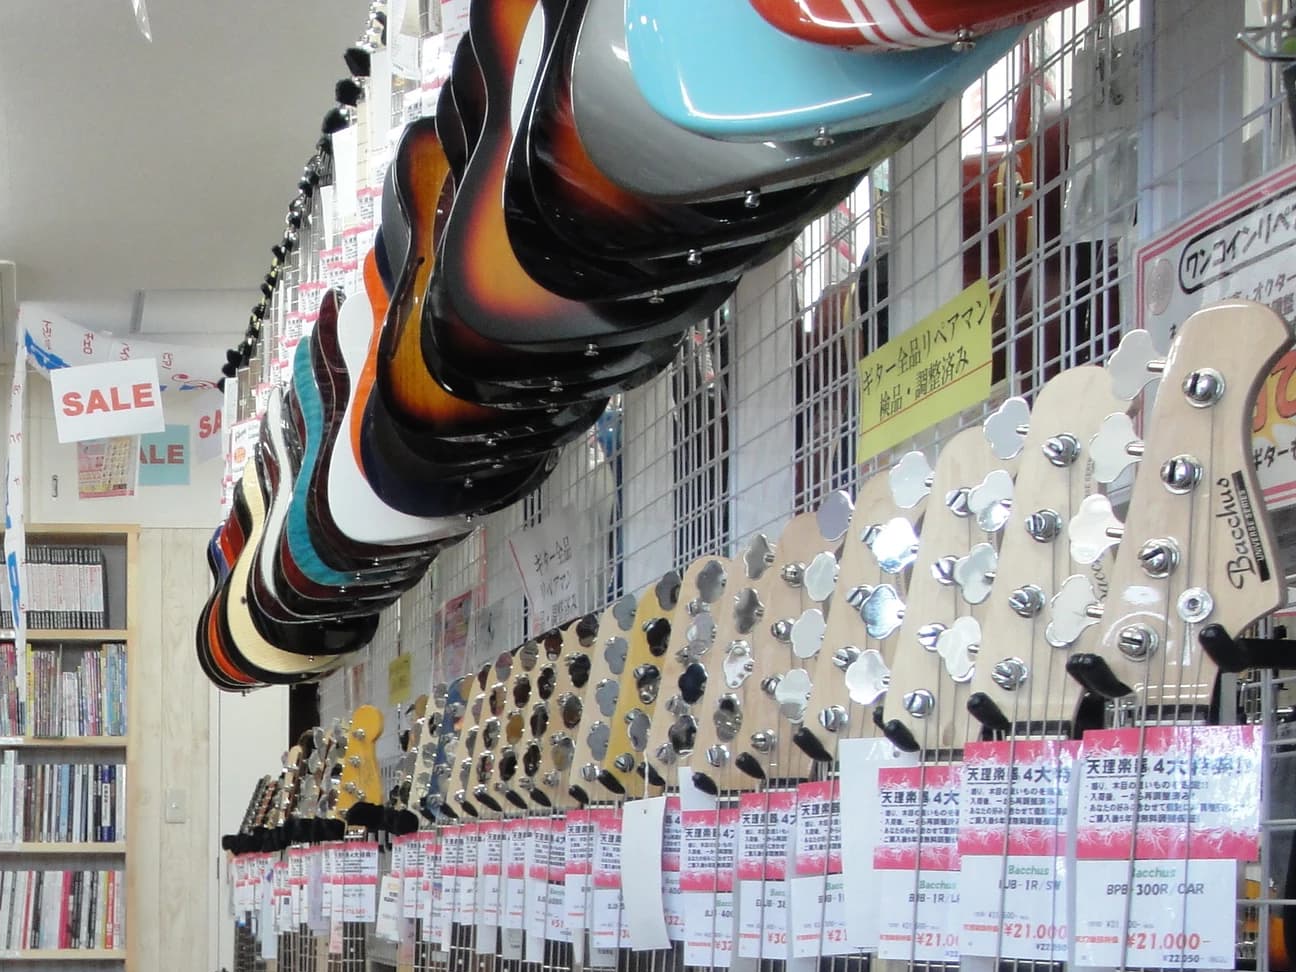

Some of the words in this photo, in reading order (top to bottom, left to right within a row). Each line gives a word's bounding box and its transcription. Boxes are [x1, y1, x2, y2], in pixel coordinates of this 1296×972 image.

[1185, 204, 1296, 280] ワンコインリペ
[862, 299, 989, 396] ギター全品リペアマン
[878, 345, 970, 418] 検品・調整済み
[62, 382, 156, 417] SALE
[1215, 477, 1256, 590] Bacchus
[1008, 864, 1050, 876] Bacchus
